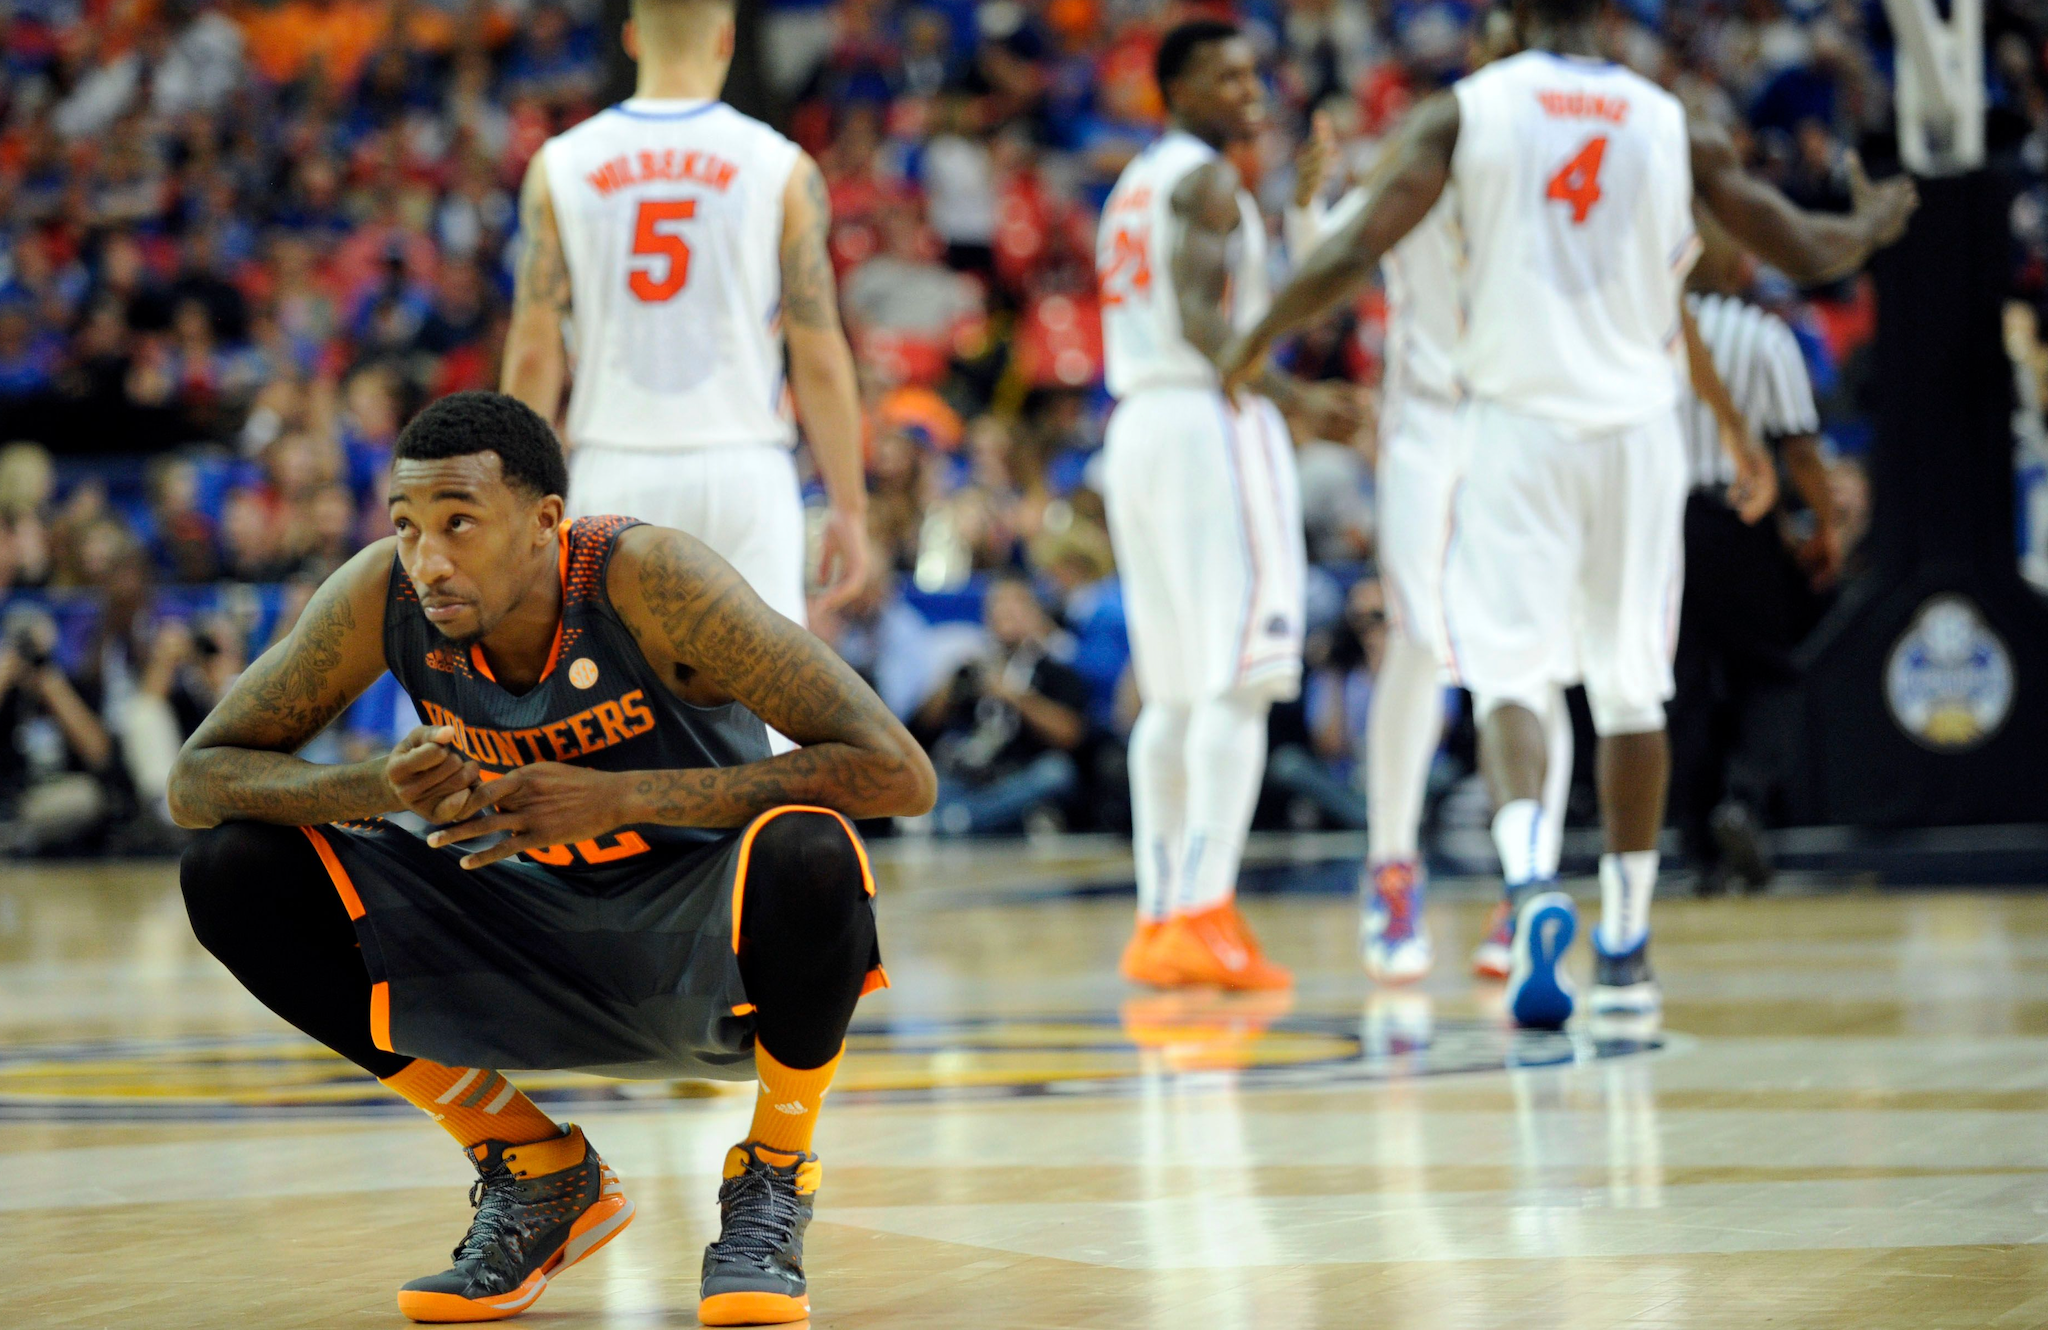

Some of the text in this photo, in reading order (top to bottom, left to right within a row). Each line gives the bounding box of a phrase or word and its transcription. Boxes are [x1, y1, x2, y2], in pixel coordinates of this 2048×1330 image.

[584, 148, 740, 197] WILBEKIN
[1545, 135, 1608, 224] 4
[629, 198, 699, 304] 5
[421, 689, 656, 767] VOLUNTEERS
